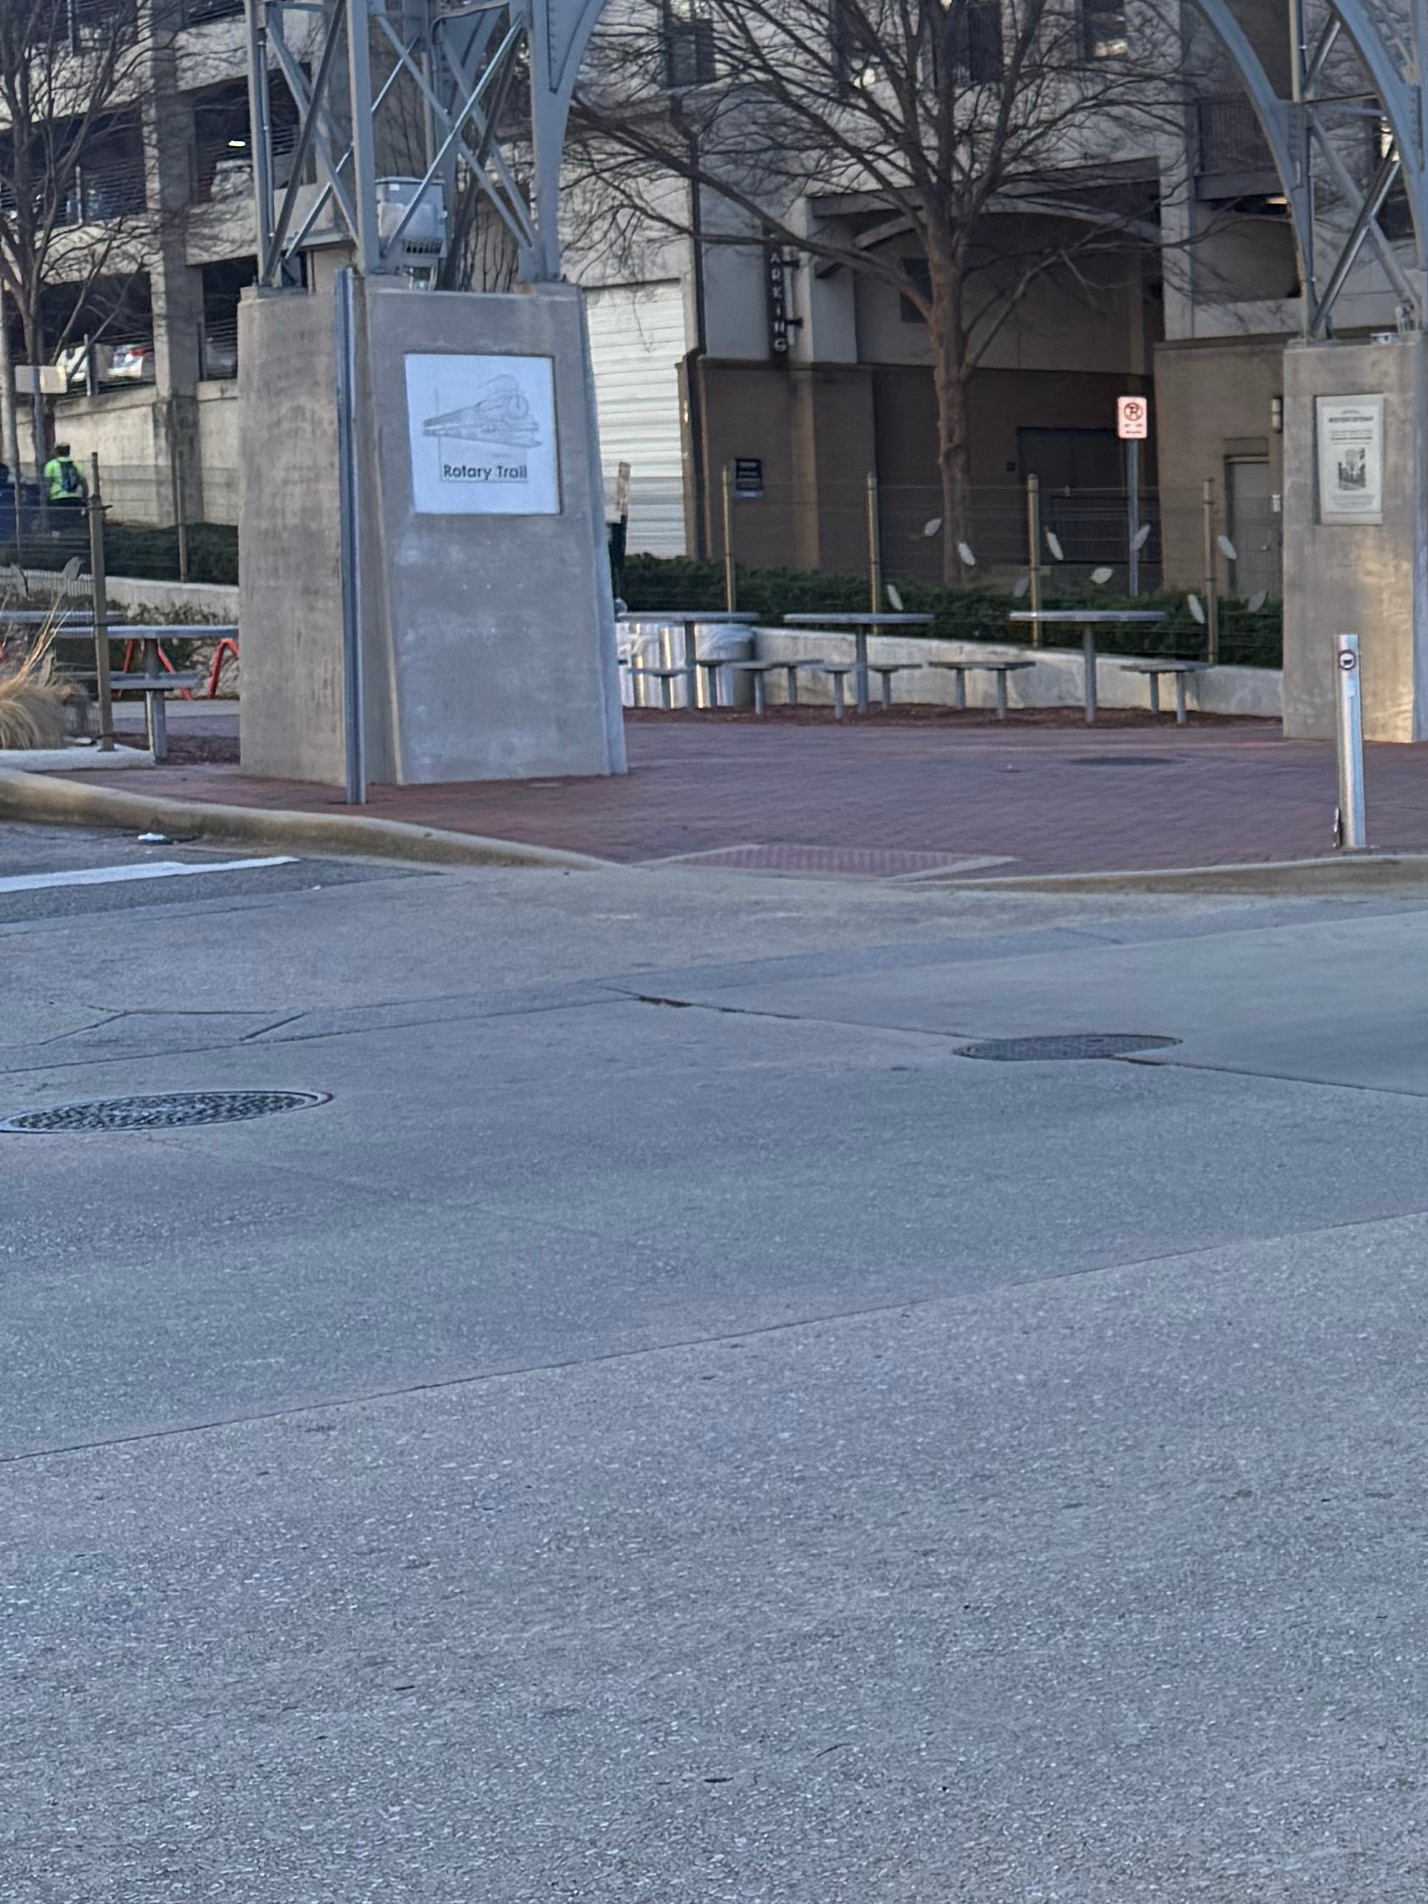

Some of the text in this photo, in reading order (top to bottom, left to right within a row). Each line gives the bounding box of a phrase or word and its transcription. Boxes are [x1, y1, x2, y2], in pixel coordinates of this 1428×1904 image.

[768, 233, 788, 353] ARKING
[443, 464, 528, 481] Rotary Trail
